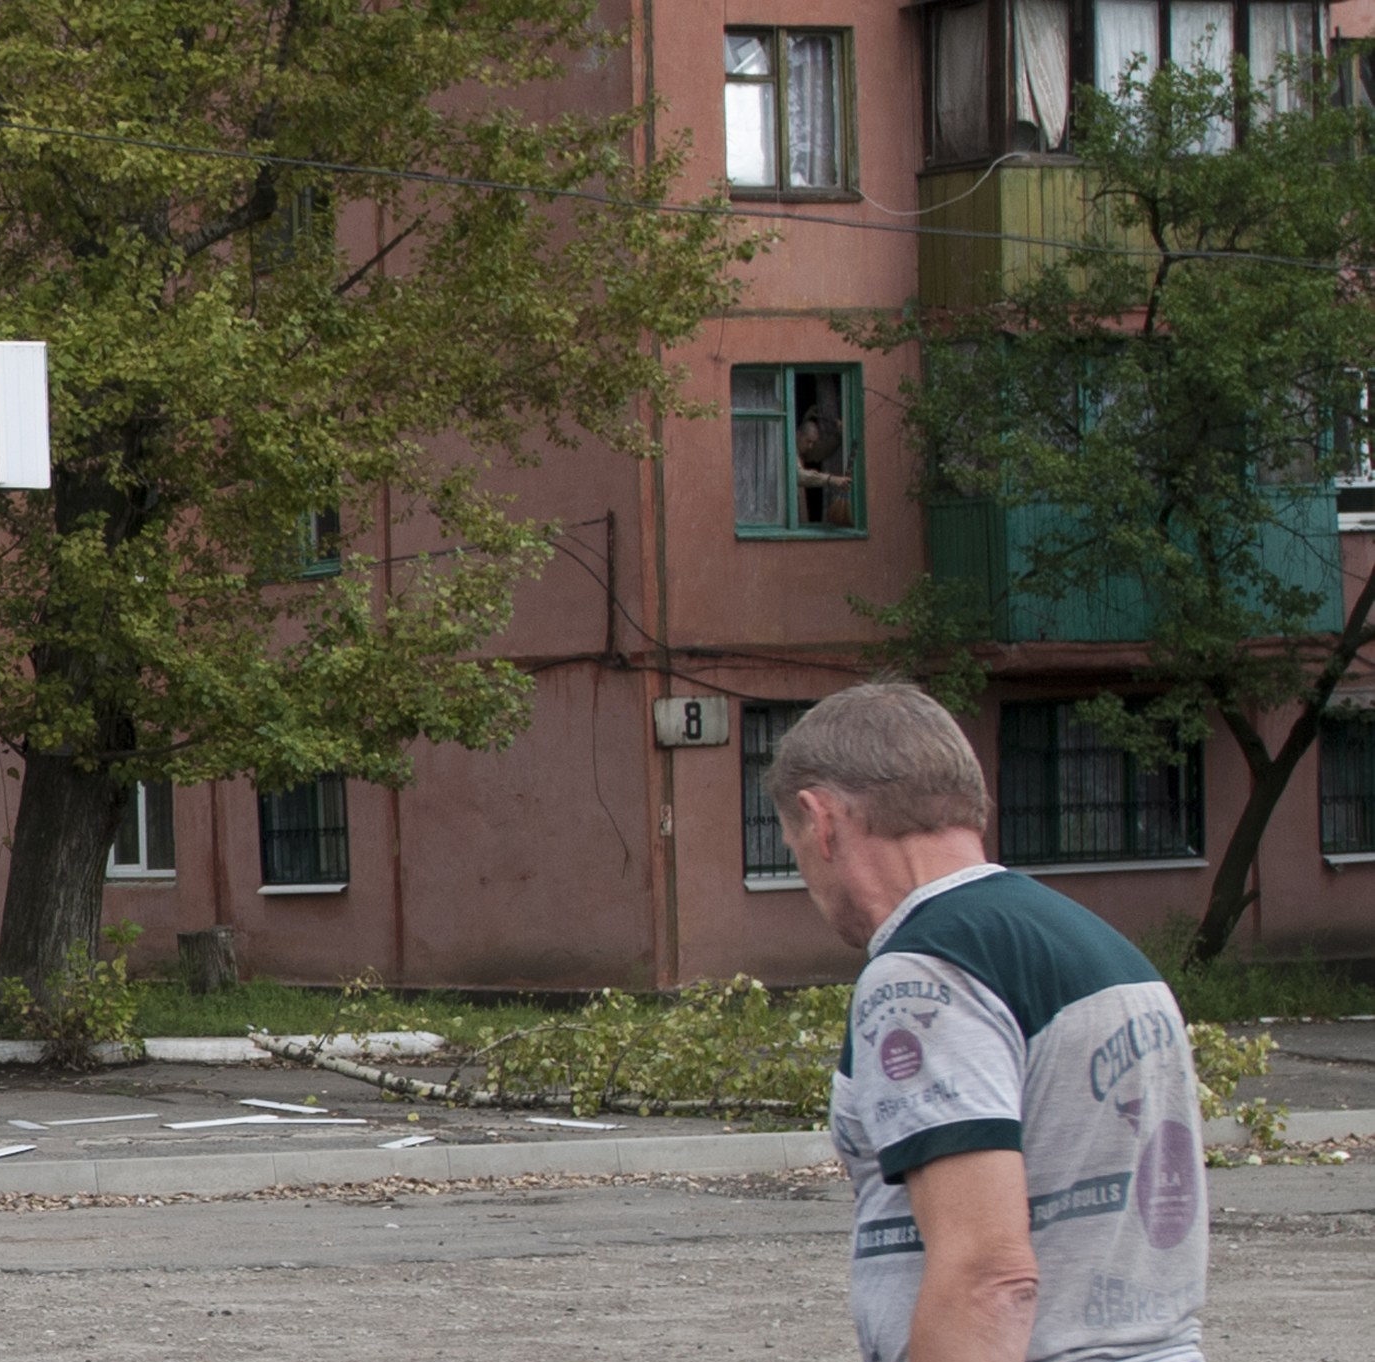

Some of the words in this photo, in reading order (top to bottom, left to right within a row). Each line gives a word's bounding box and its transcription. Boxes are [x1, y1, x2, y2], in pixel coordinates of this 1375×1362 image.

[684, 702, 702, 740] 8
[894, 980, 952, 1006] BULLS
[1072, 1183, 1121, 1209] BULLS
